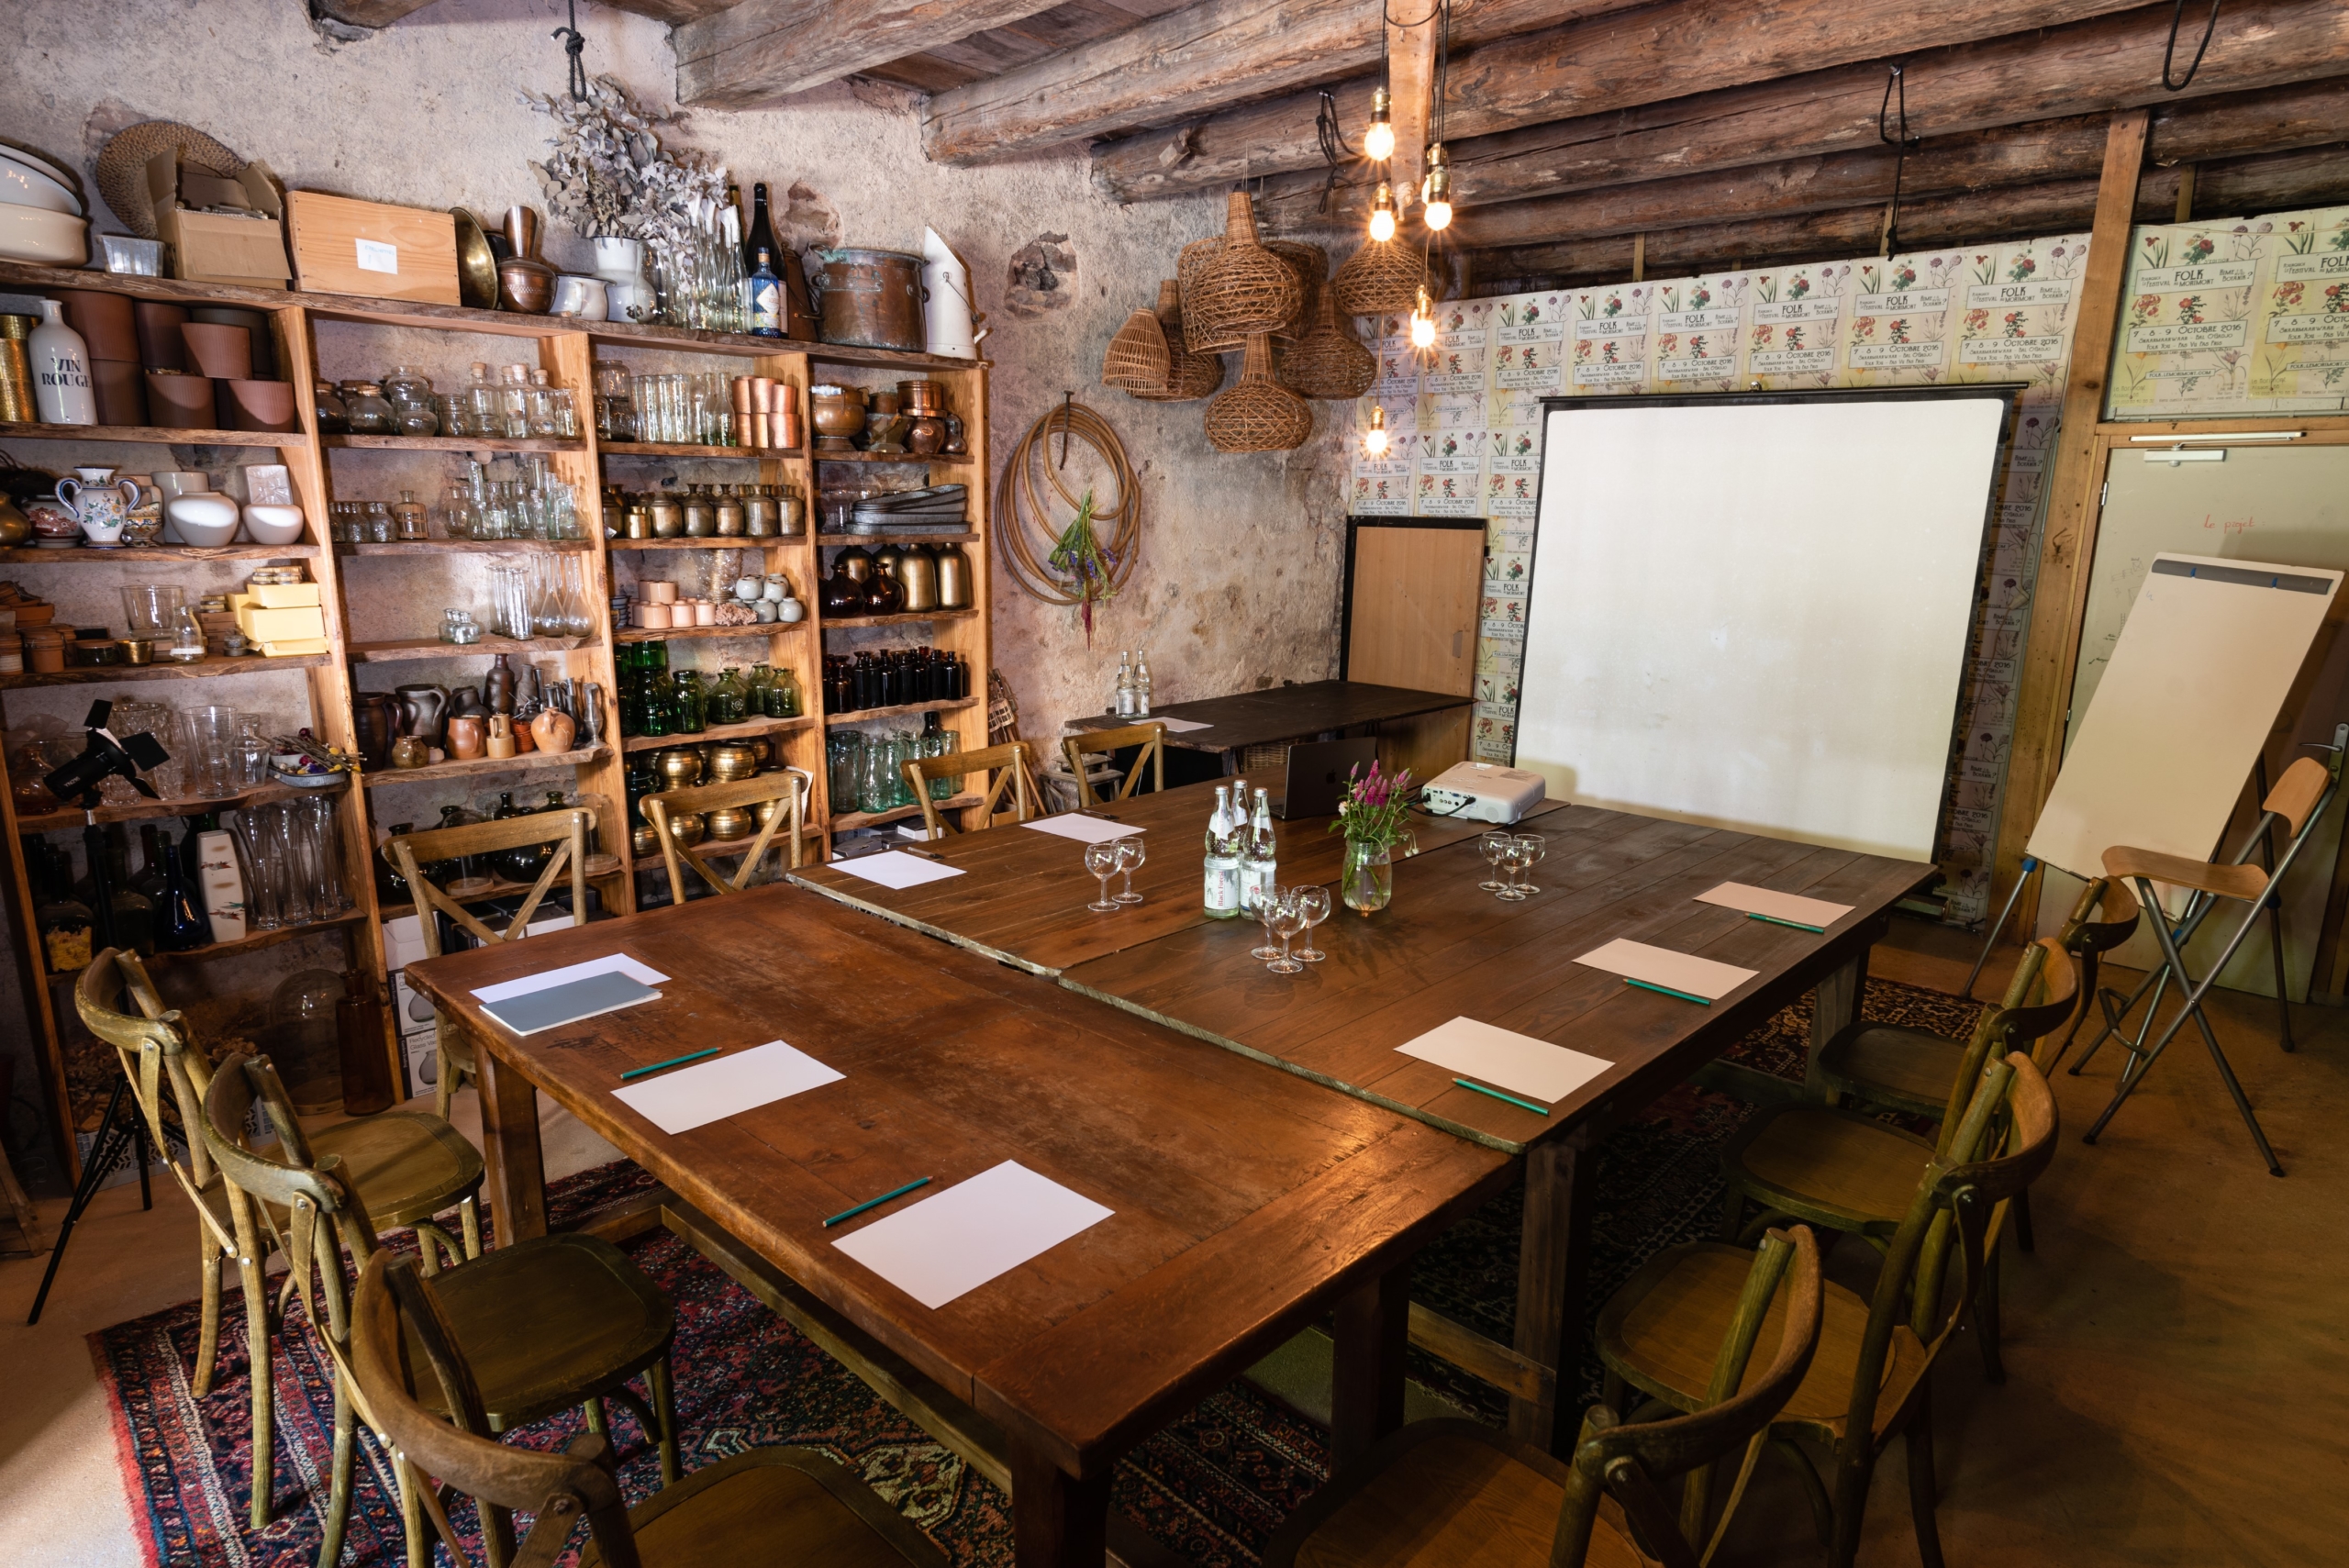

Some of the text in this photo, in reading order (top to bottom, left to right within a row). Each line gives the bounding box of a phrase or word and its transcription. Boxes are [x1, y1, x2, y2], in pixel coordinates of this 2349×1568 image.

[2174, 270, 2204, 281] FOLK
[2001, 288, 2027, 297] FOLK
[2220, 324, 2242, 333] 2016
[51, 358, 81, 372] VIN
[41, 373, 91, 388] ROUGE
[1499, 706, 1514, 714] FOLK
[410, 1033, 435, 1044] Recycled
